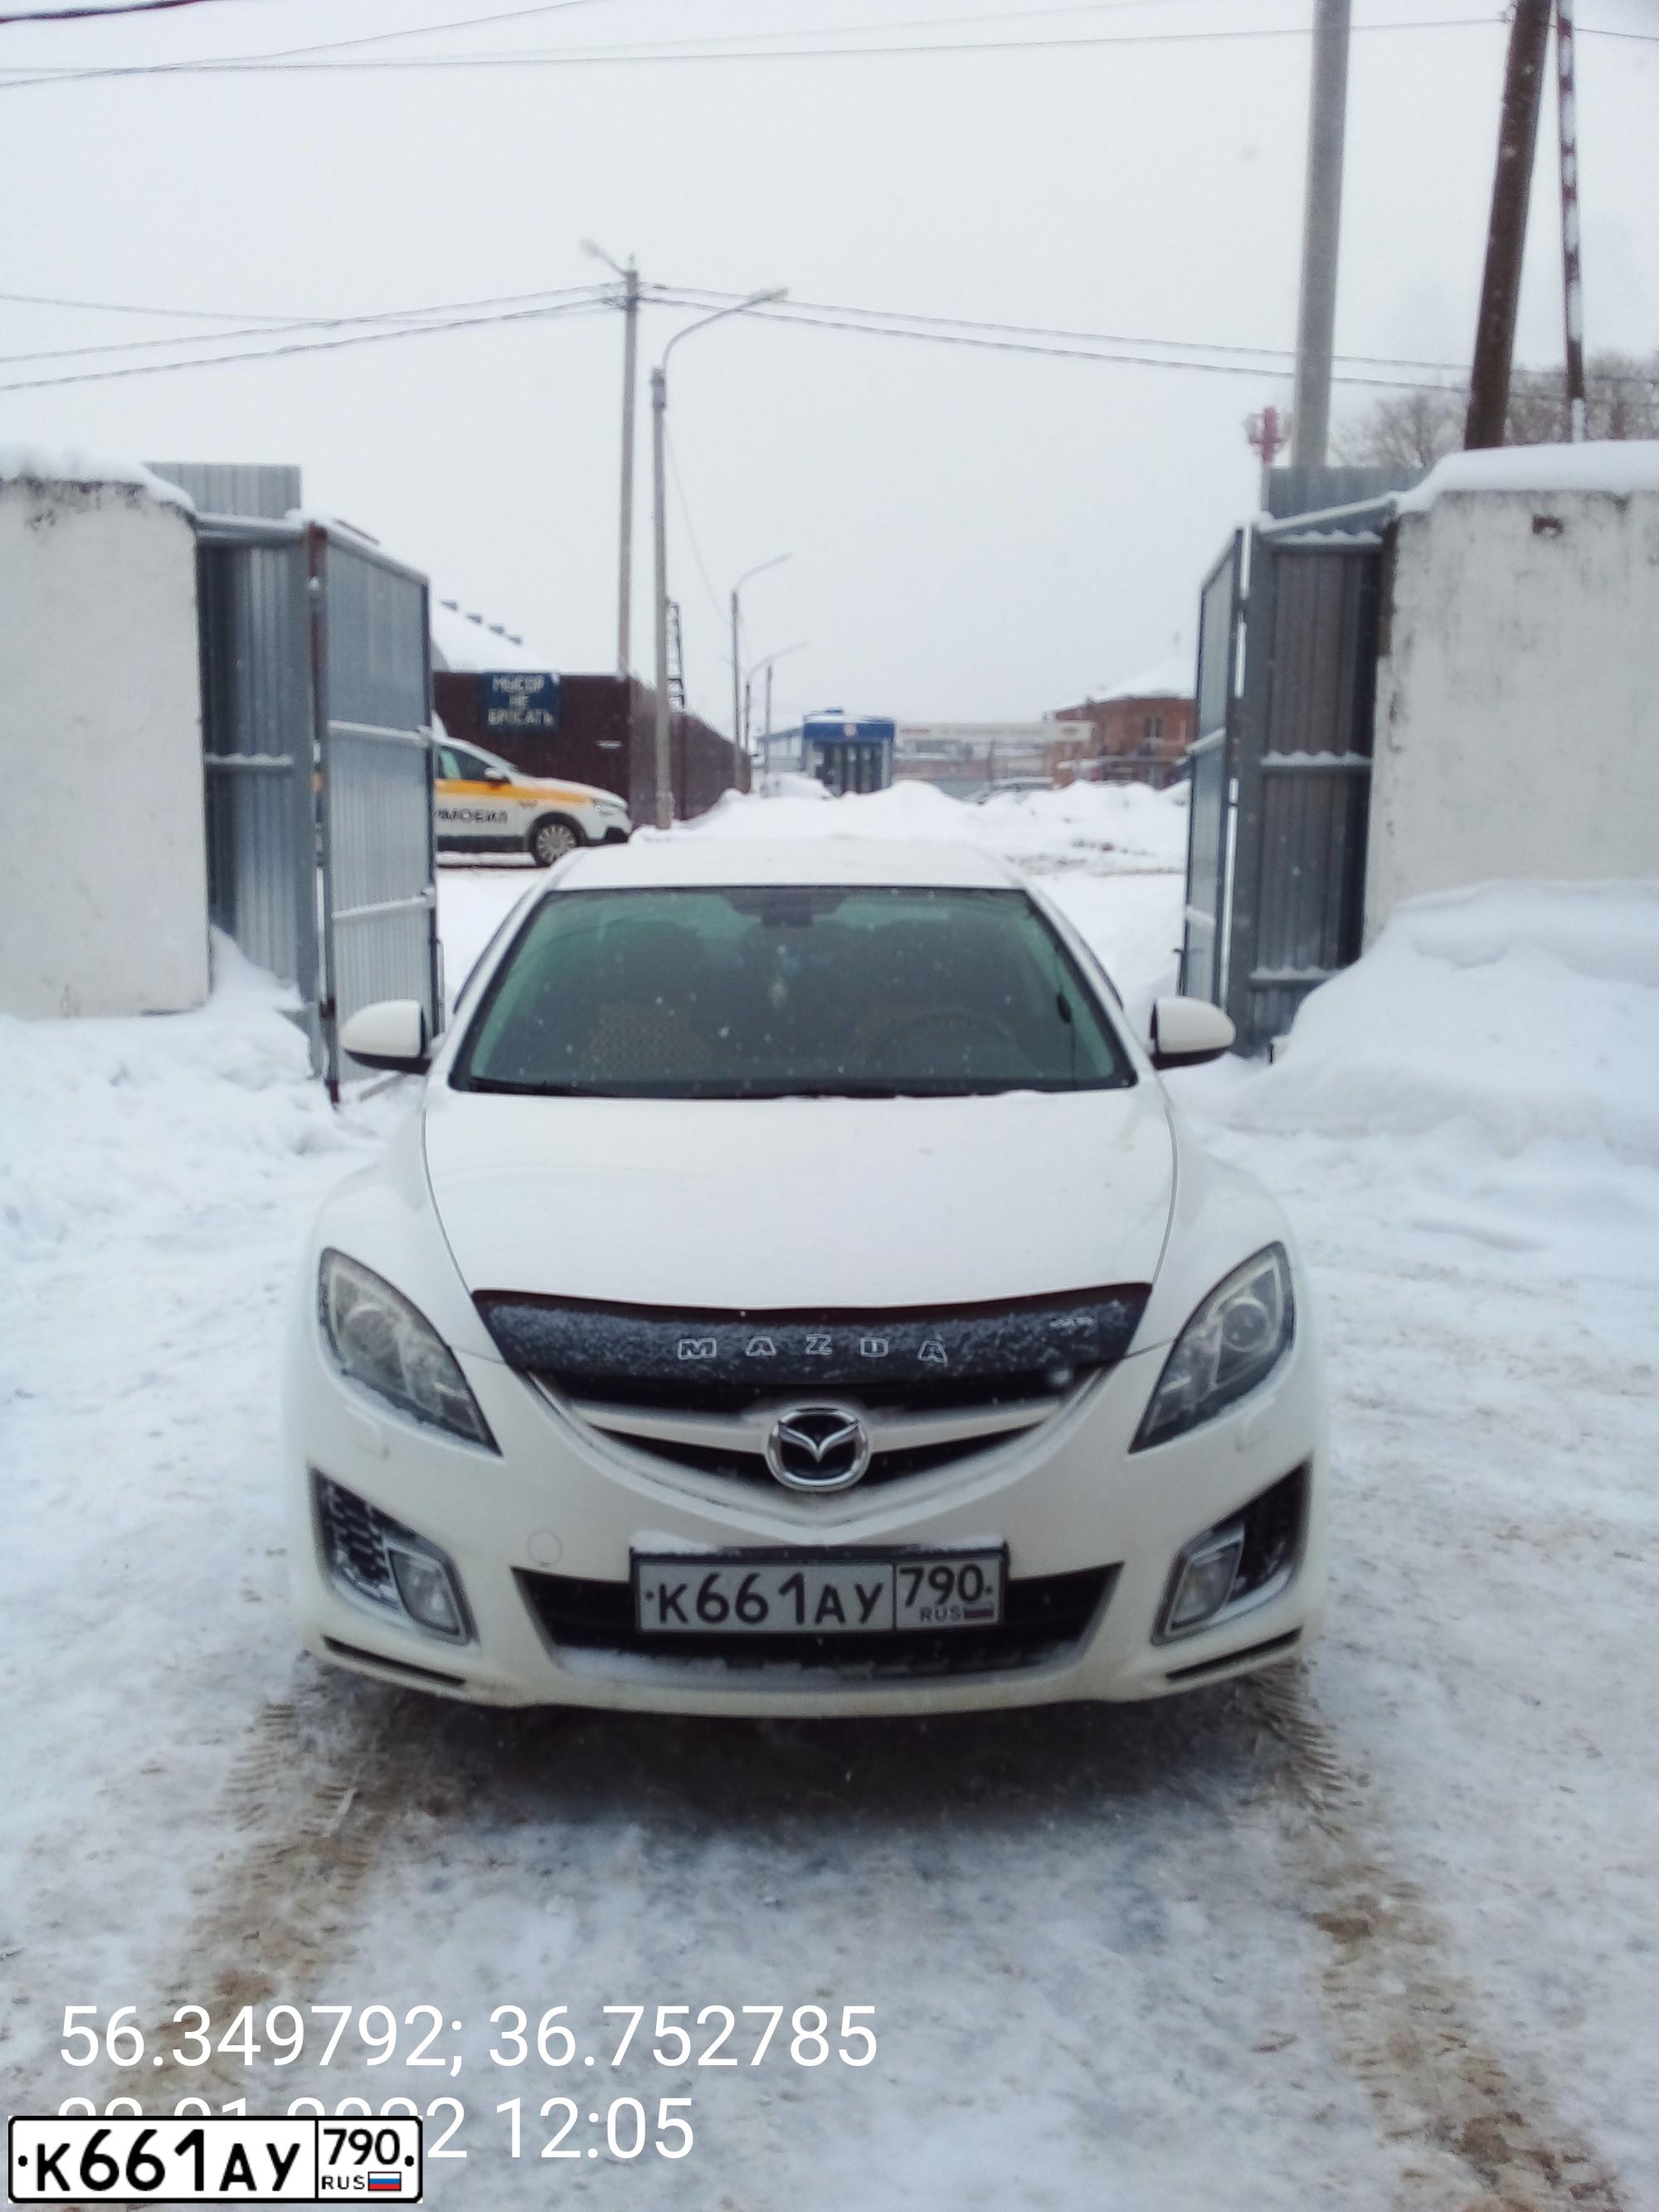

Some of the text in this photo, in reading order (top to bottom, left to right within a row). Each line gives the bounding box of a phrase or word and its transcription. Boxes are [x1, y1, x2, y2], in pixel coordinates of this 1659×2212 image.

[677, 1333, 947, 1363] MAZDA
[899, 1563, 985, 1608] 790
[920, 1605, 962, 1622] RUS
